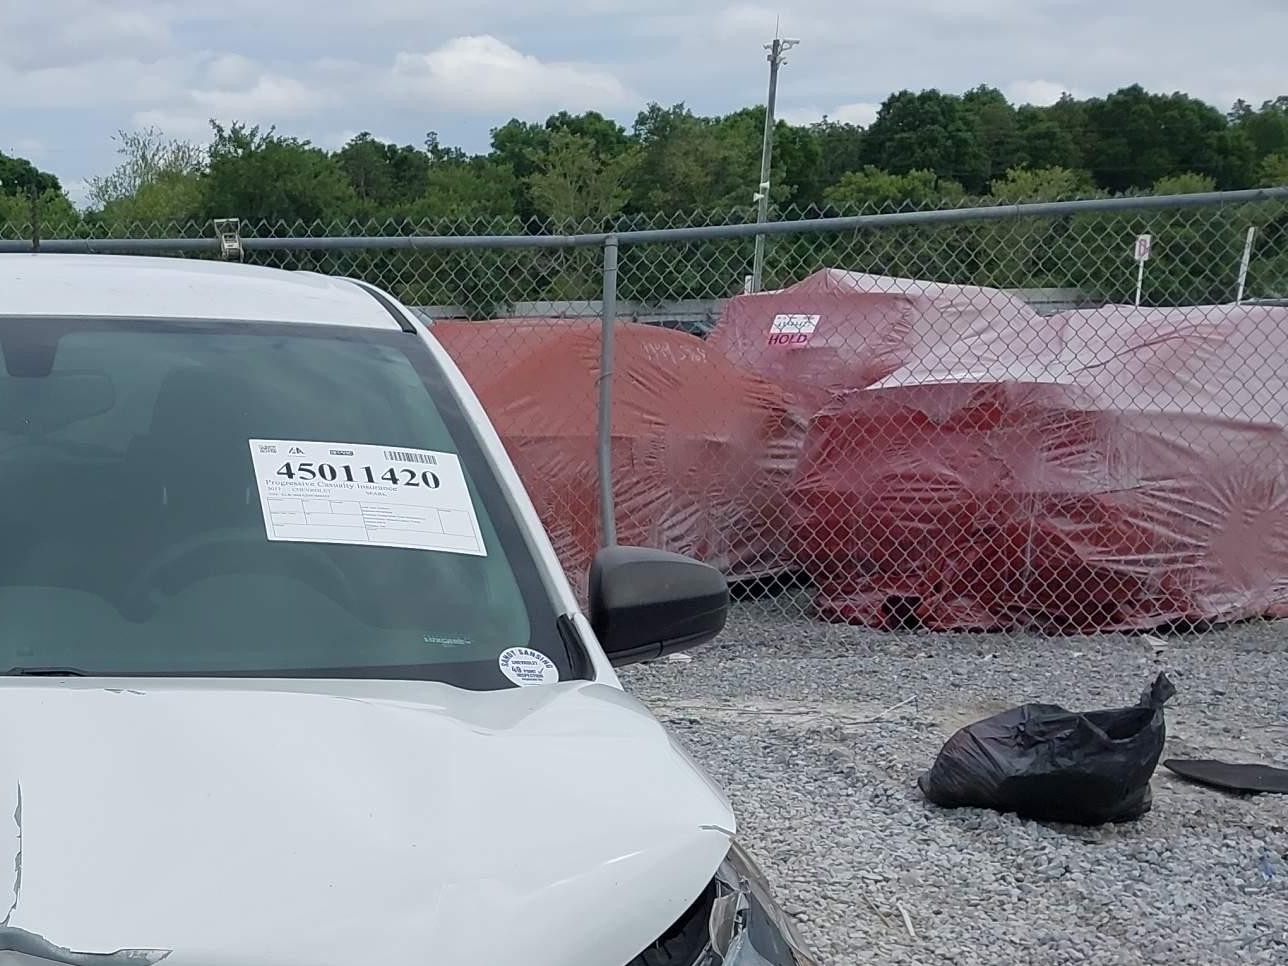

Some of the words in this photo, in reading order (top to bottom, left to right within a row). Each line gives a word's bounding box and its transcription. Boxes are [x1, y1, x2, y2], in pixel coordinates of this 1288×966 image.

[768, 334, 808, 345] HOLD
[277, 462, 440, 490] 45011420
[317, 481, 353, 489] Casualty
[357, 483, 397, 492] Insurance
[501, 650, 516, 667] SANDY
[518, 649, 553, 669] SANSING
